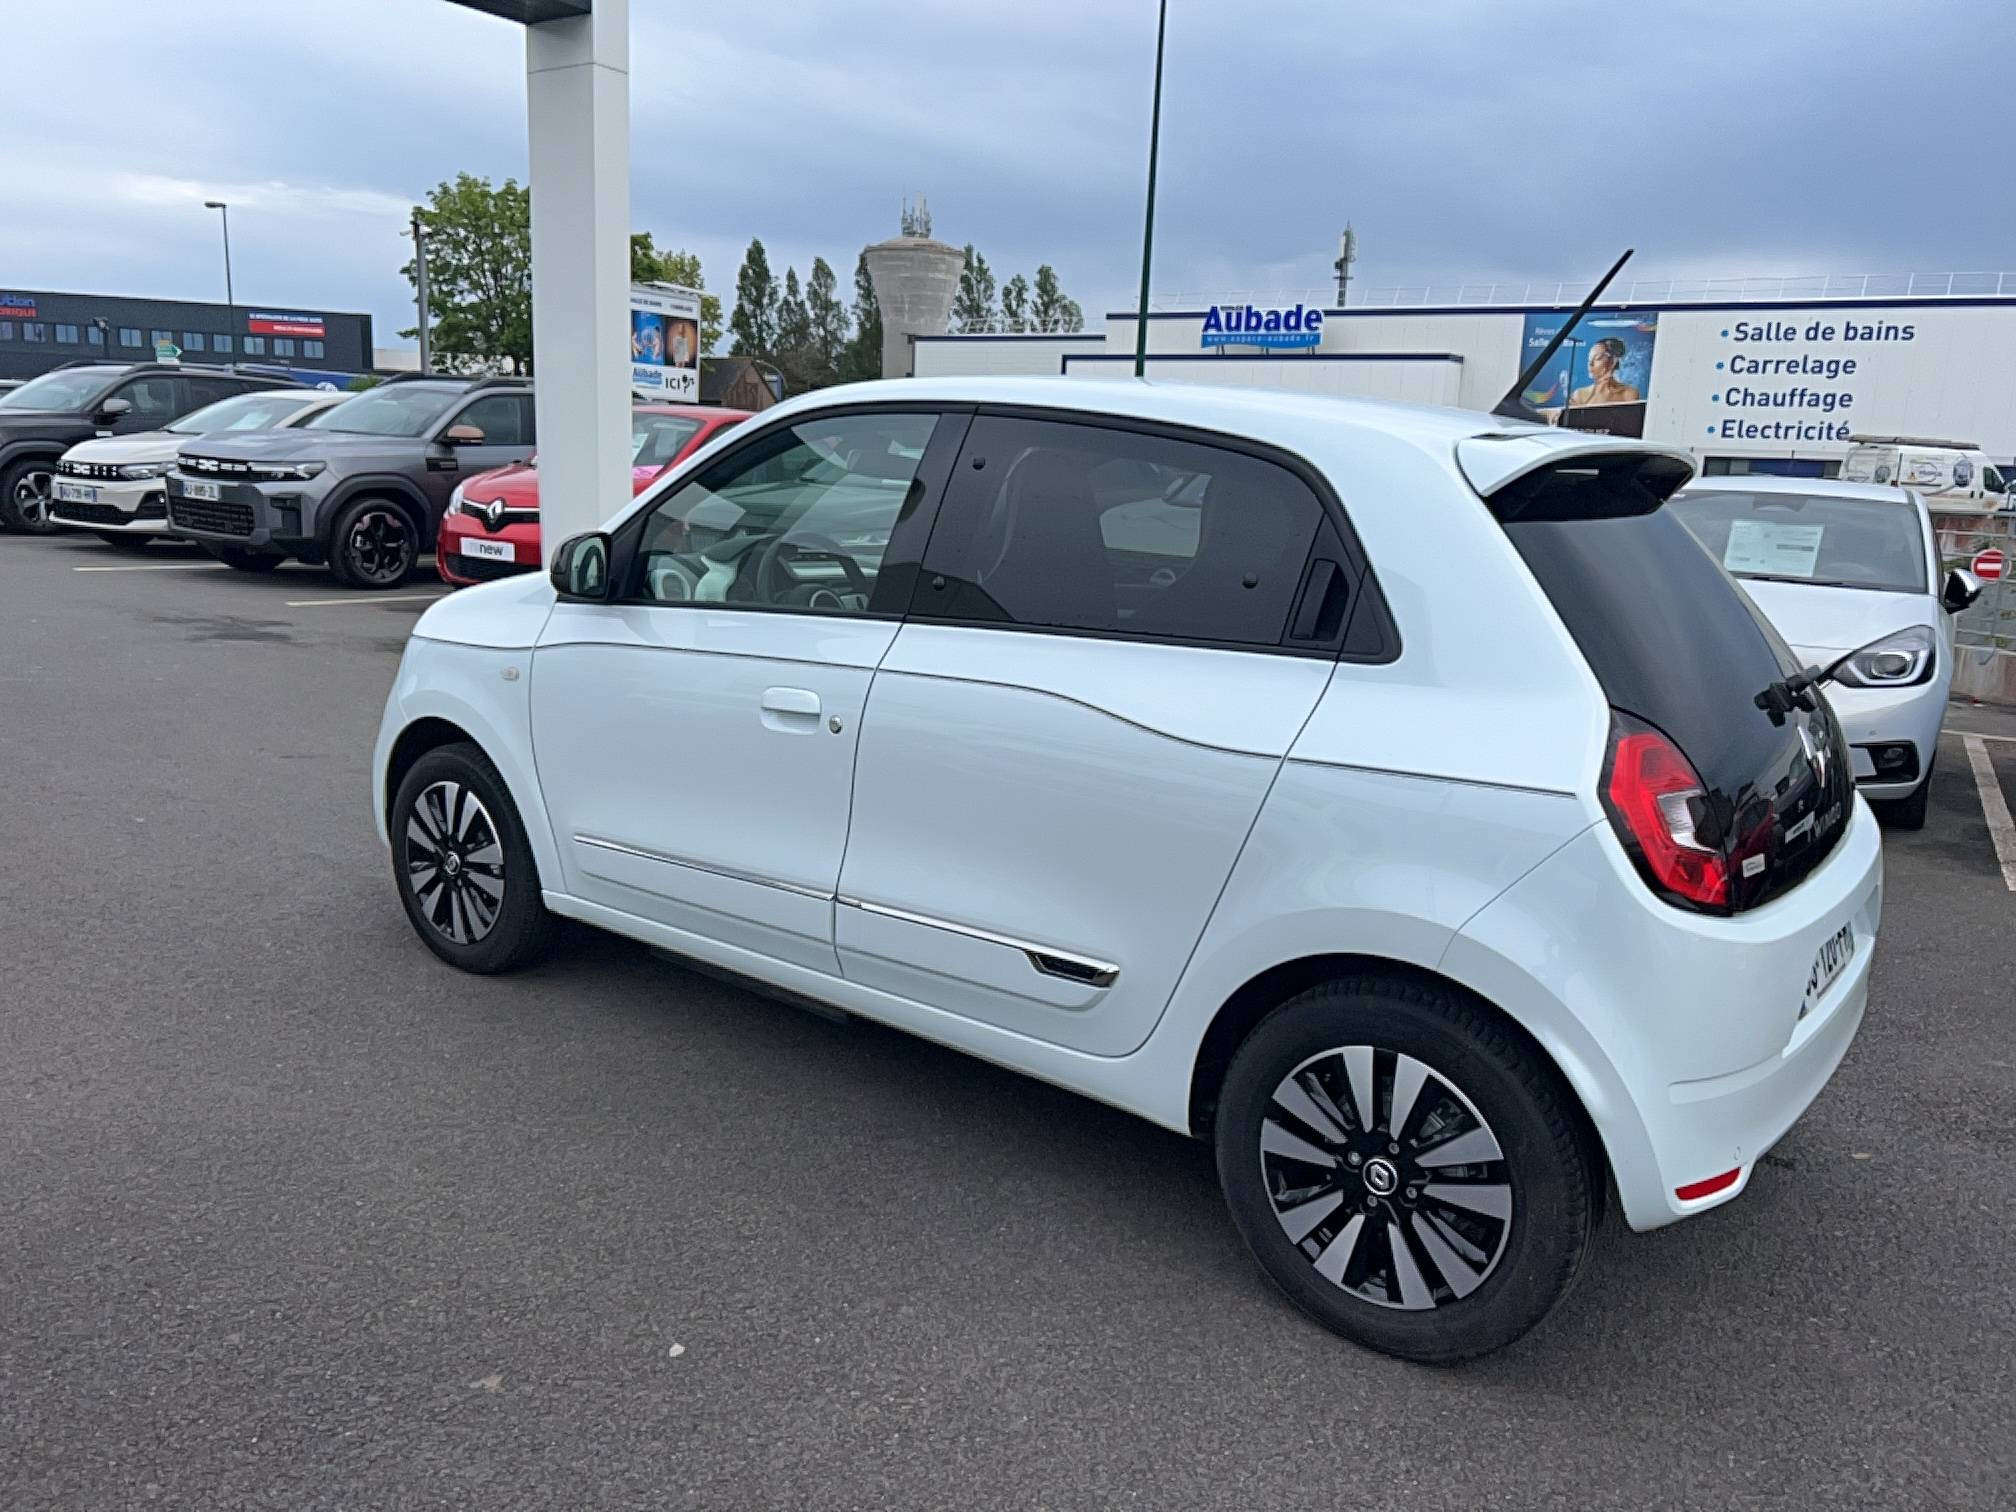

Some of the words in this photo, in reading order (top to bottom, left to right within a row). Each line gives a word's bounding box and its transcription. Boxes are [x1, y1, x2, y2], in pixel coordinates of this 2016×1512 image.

[1202, 303, 1323, 333] Aubade
[1733, 322, 1797, 341] Salle
[1805, 321, 1836, 341] de
[1844, 321, 1916, 341] bains
[1730, 355, 1857, 379] Carrelage
[1725, 387, 1854, 412] Chauffage
[1720, 419, 1850, 441] Electricité
